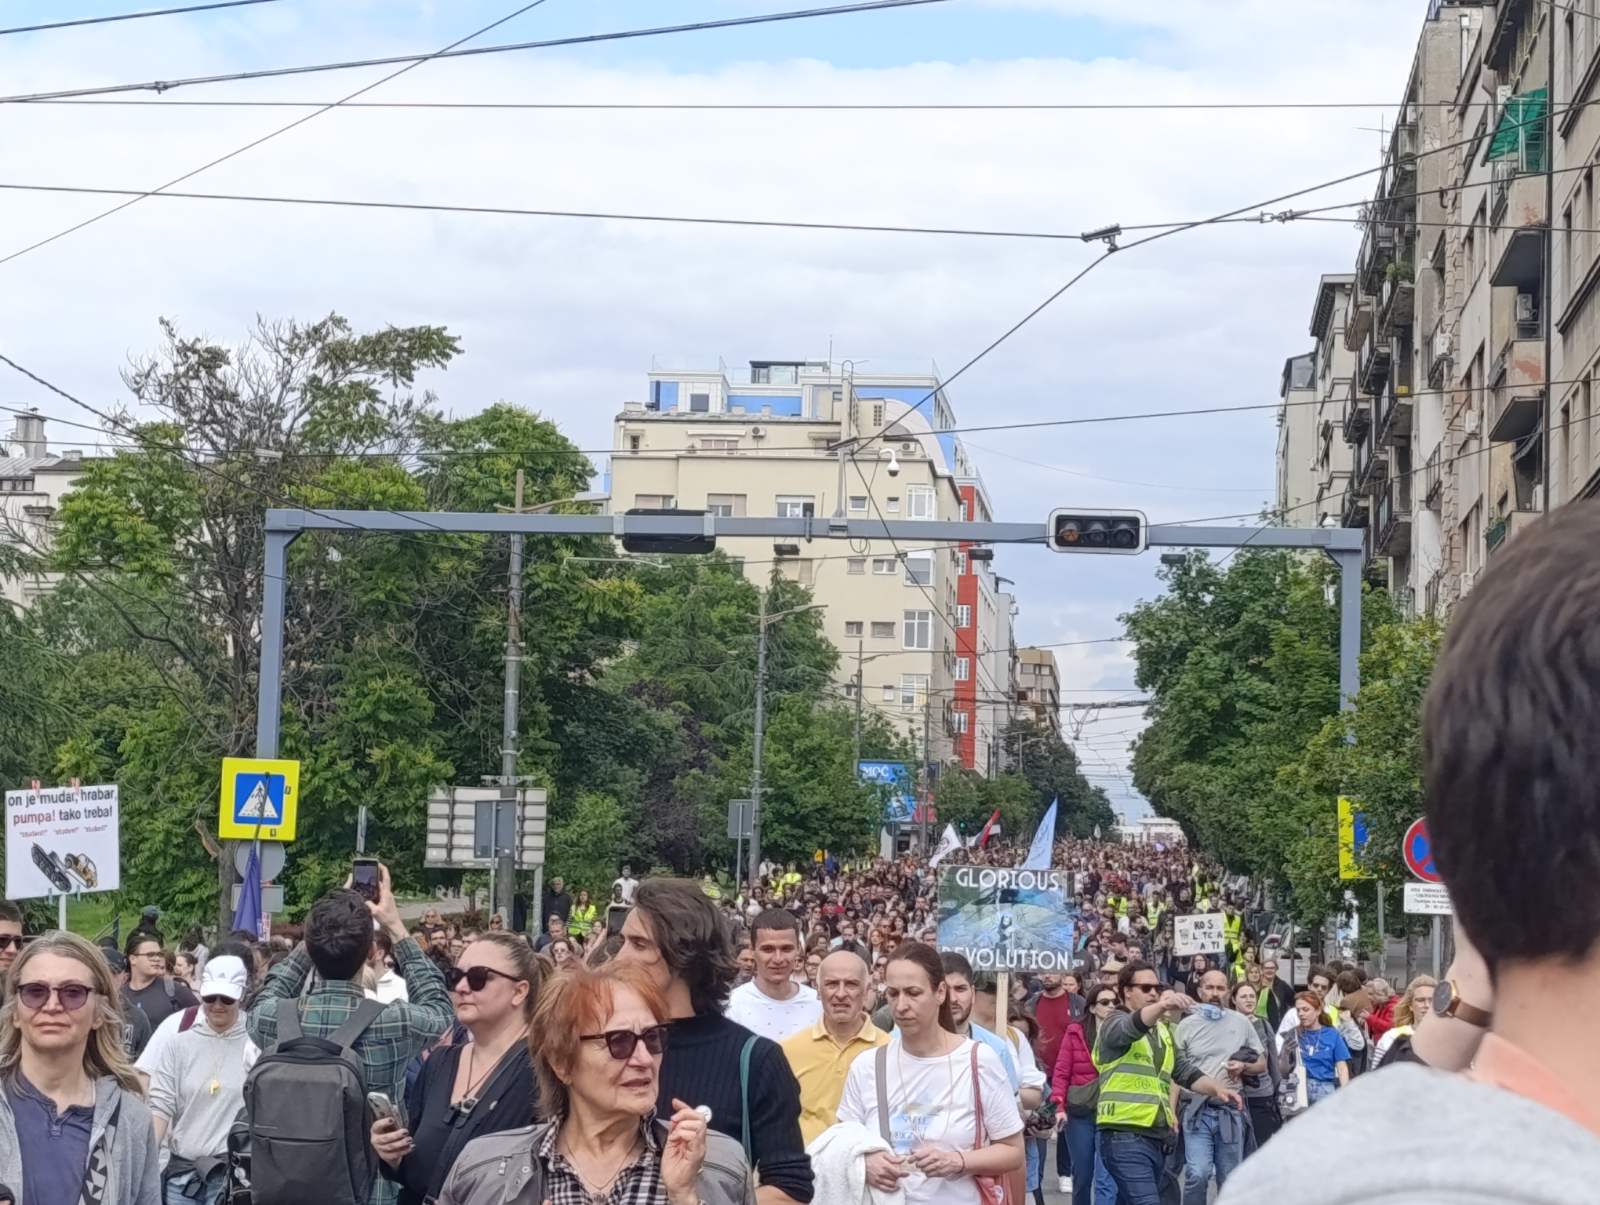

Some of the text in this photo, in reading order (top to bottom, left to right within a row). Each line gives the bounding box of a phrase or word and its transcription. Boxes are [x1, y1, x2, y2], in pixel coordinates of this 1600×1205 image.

[8, 795, 22, 807] on
[25, 792, 36, 808] je
[13, 805, 112, 826] pumpa! tako treba!
[955, 868, 1059, 891] GLORIOUS
